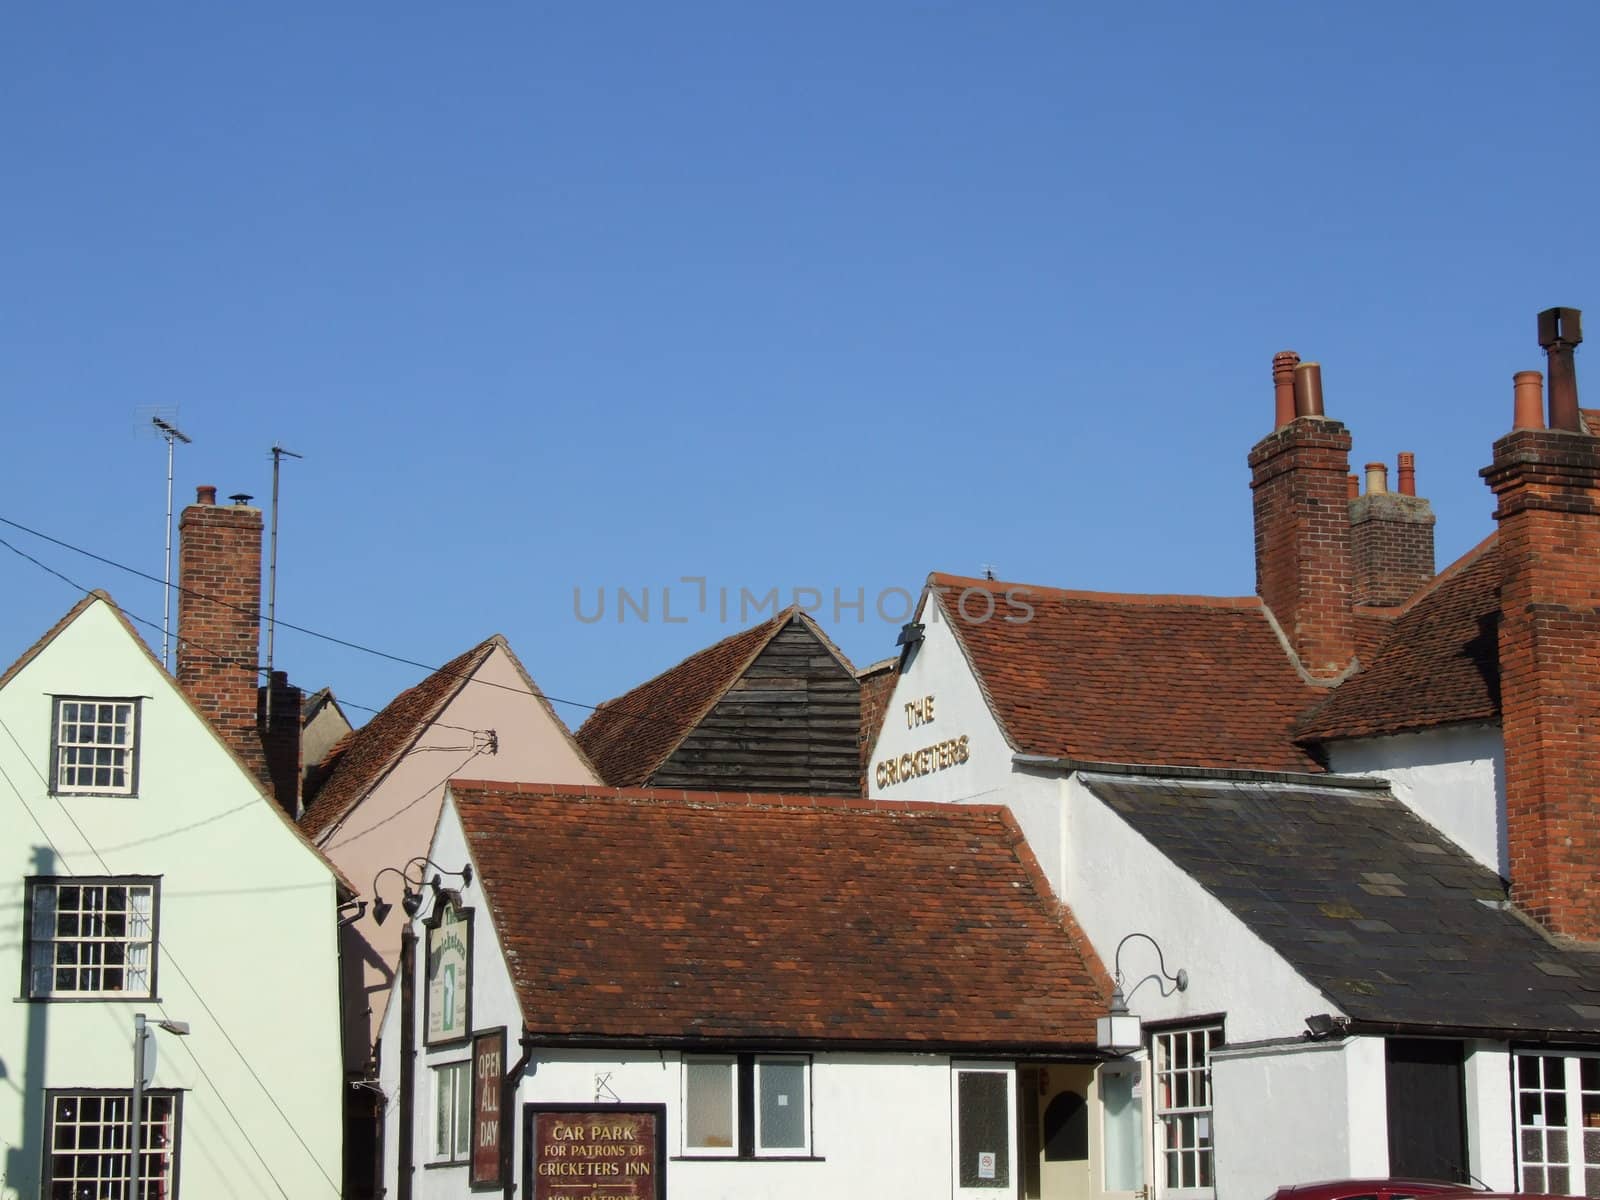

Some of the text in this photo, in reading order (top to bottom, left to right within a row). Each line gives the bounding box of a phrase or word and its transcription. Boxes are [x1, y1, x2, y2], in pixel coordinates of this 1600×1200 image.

[905, 696, 935, 730] THE
[876, 735, 970, 790] CRICKETERS
[479, 1051, 501, 1079] OPEN
[481, 1087, 499, 1112] ALL
[480, 1121, 499, 1147] DAY
[553, 1126, 634, 1141] CAR PARK
[544, 1145, 645, 1157] FOR PATRONS OF
[538, 1162, 650, 1176] CRICKETERS INN
